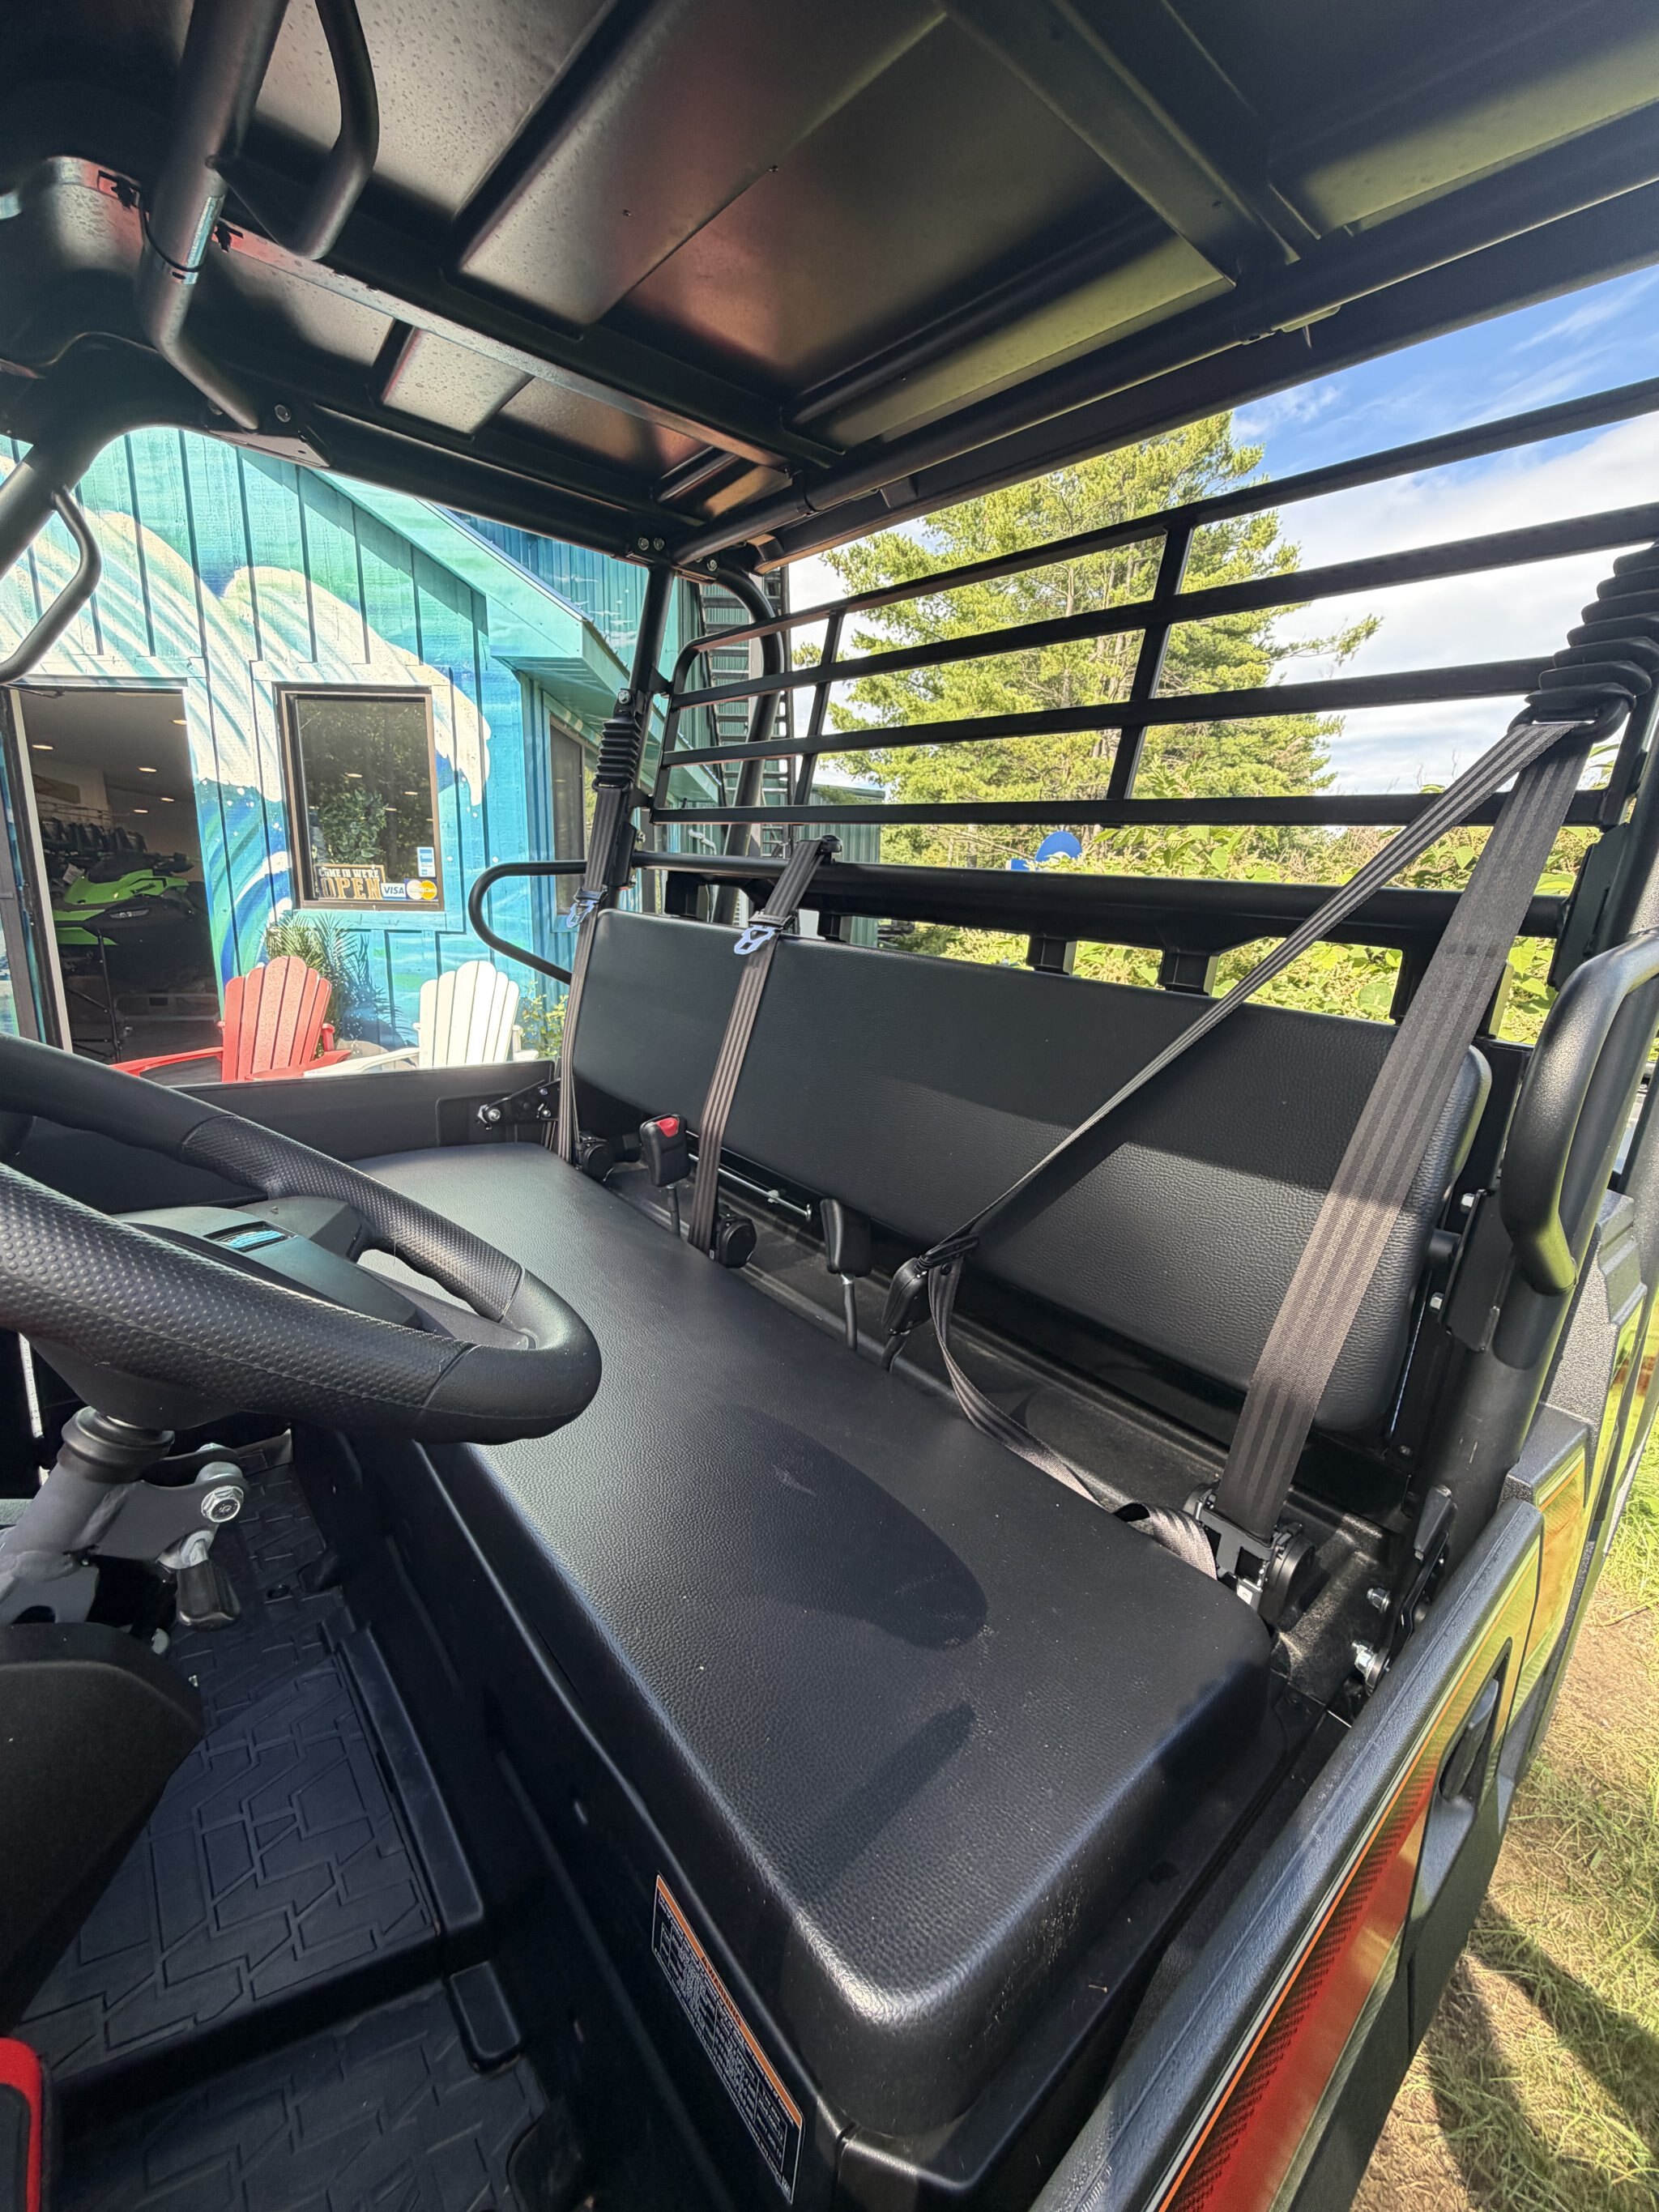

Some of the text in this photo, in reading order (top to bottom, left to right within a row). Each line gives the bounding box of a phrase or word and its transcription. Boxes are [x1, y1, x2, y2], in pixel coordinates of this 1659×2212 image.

[341, 868, 352, 878] IN
[321, 877, 382, 900] OPEN
[384, 886, 405, 894] VISA
[706, 1964, 741, 2027] WARNING
